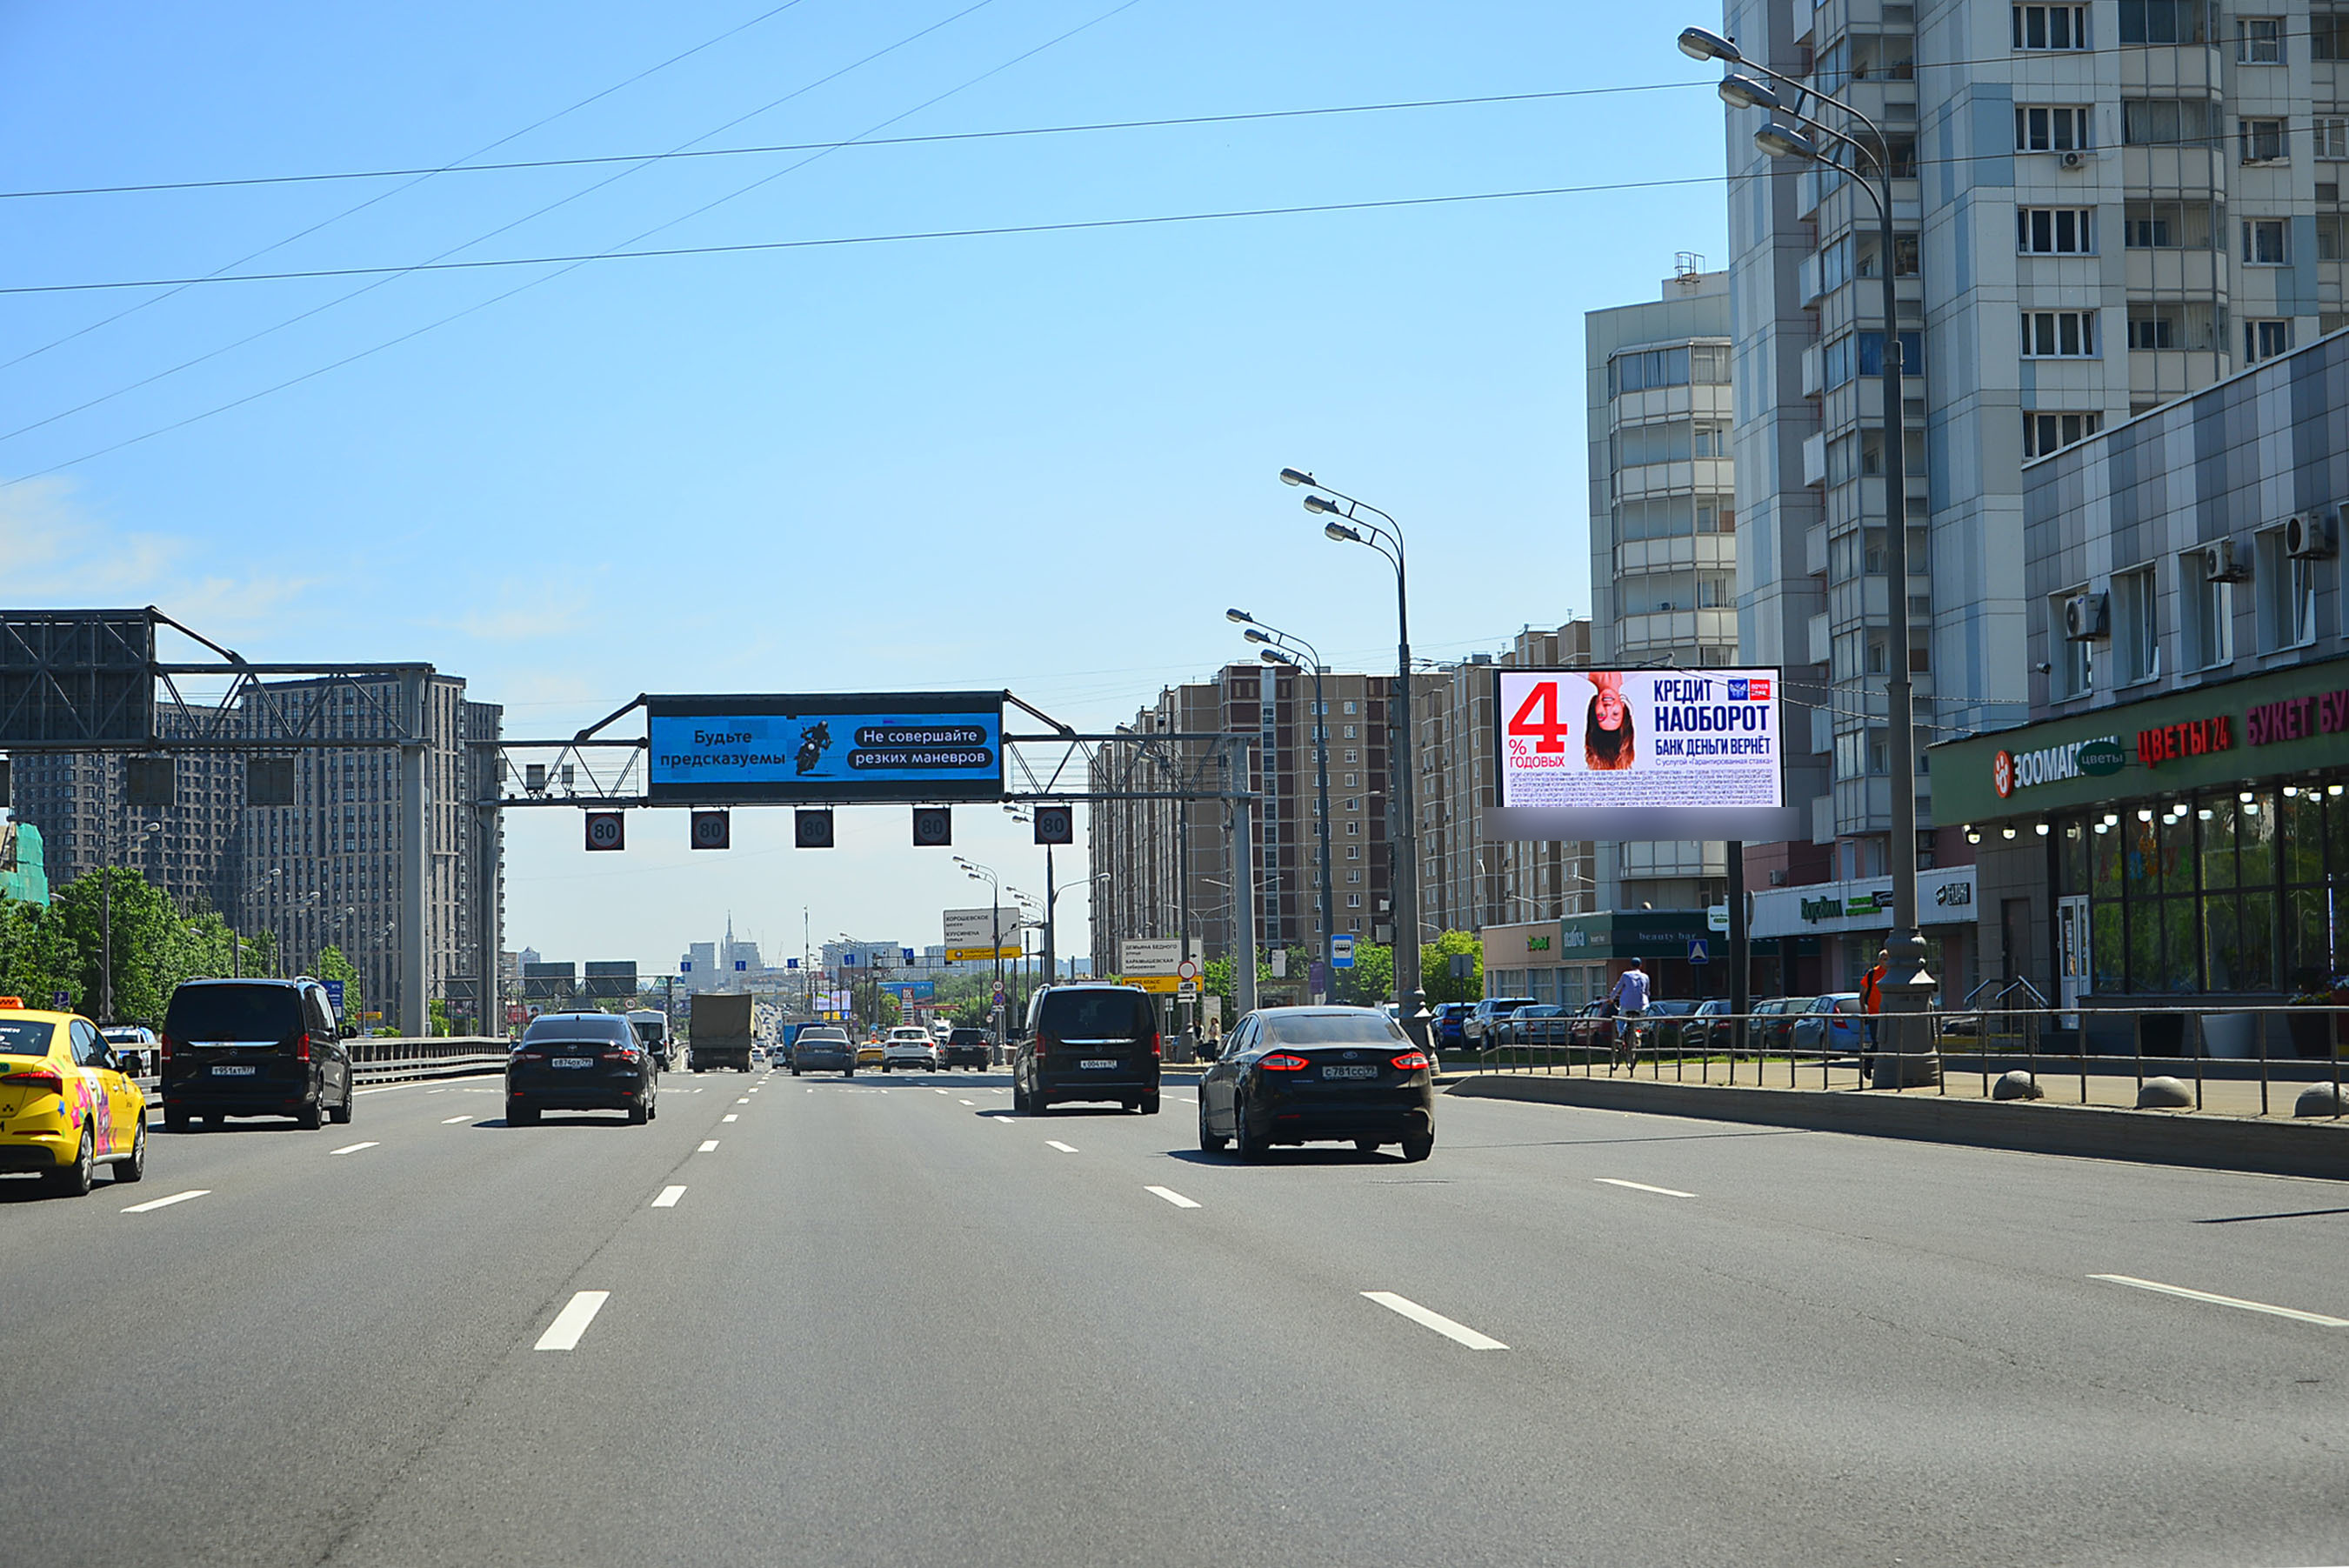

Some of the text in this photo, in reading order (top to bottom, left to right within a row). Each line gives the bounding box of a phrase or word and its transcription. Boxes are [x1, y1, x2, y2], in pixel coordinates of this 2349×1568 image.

[1654, 679, 1712, 704] КРЕДИТ
[1509, 682, 1567, 753] 4
[1655, 705, 1770, 731] НАОБОРОТ
[2246, 697, 2312, 746] БУКЕТ
[695, 731, 752, 746] Будьте
[864, 729, 978, 744] Не совершайте
[2138, 716, 2232, 769] ЦВЕТЫ 24
[1509, 739, 1527, 755] %
[1656, 735, 1772, 757] БАНК ДЕНЬГИ ВЕРНЁТ
[660, 753, 786, 768] предсказуемы
[856, 752, 986, 766] резких маневров
[2081, 753, 2123, 766] цветы
[594, 824, 616, 839] 80
[699, 822, 721, 838] 80
[804, 820, 825, 837] 80
[921, 819, 944, 835] 80
[1044, 817, 1064, 833] 80
[1639, 931, 1696, 941] beauty bar
